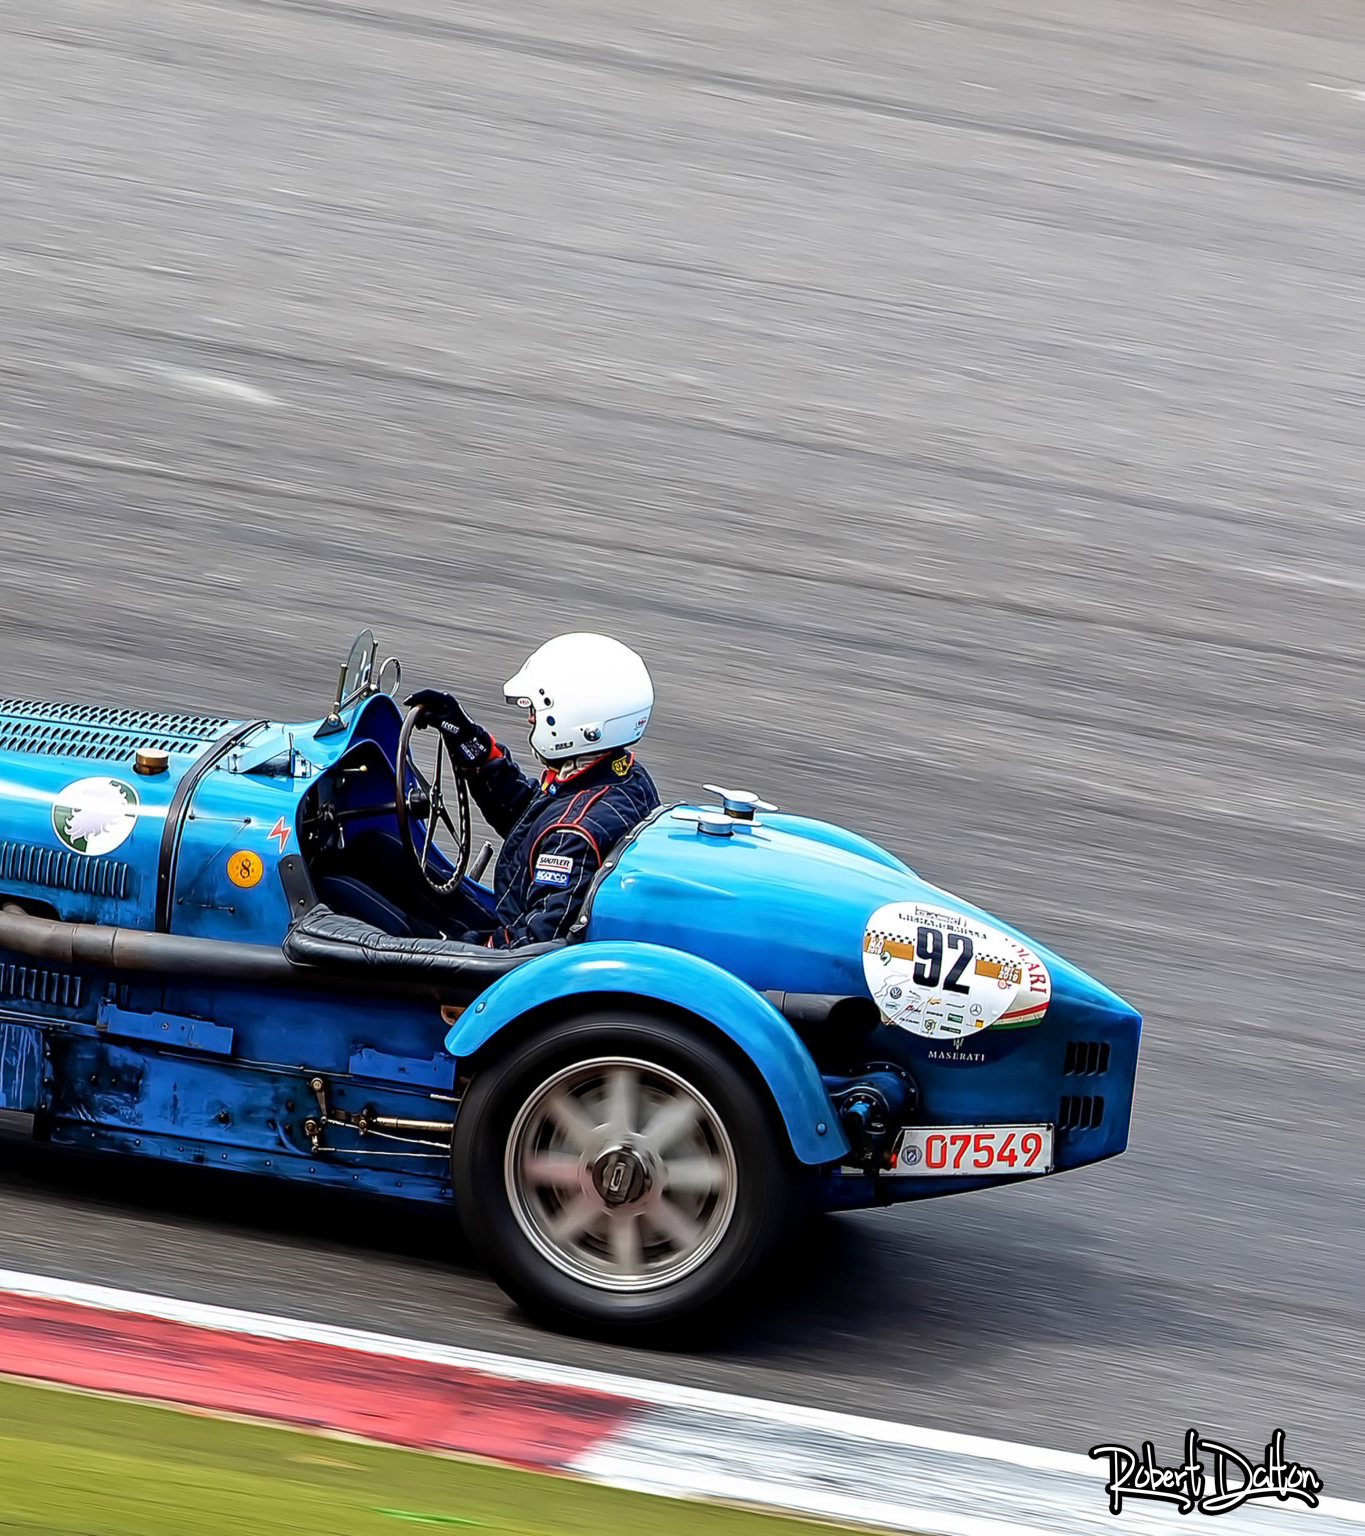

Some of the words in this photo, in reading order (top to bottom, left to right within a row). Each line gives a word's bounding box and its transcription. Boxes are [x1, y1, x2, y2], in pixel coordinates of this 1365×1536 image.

[912, 926, 974, 996] 92
[927, 1050, 985, 1062] MASERATI
[925, 1133, 1042, 1169] 07549
